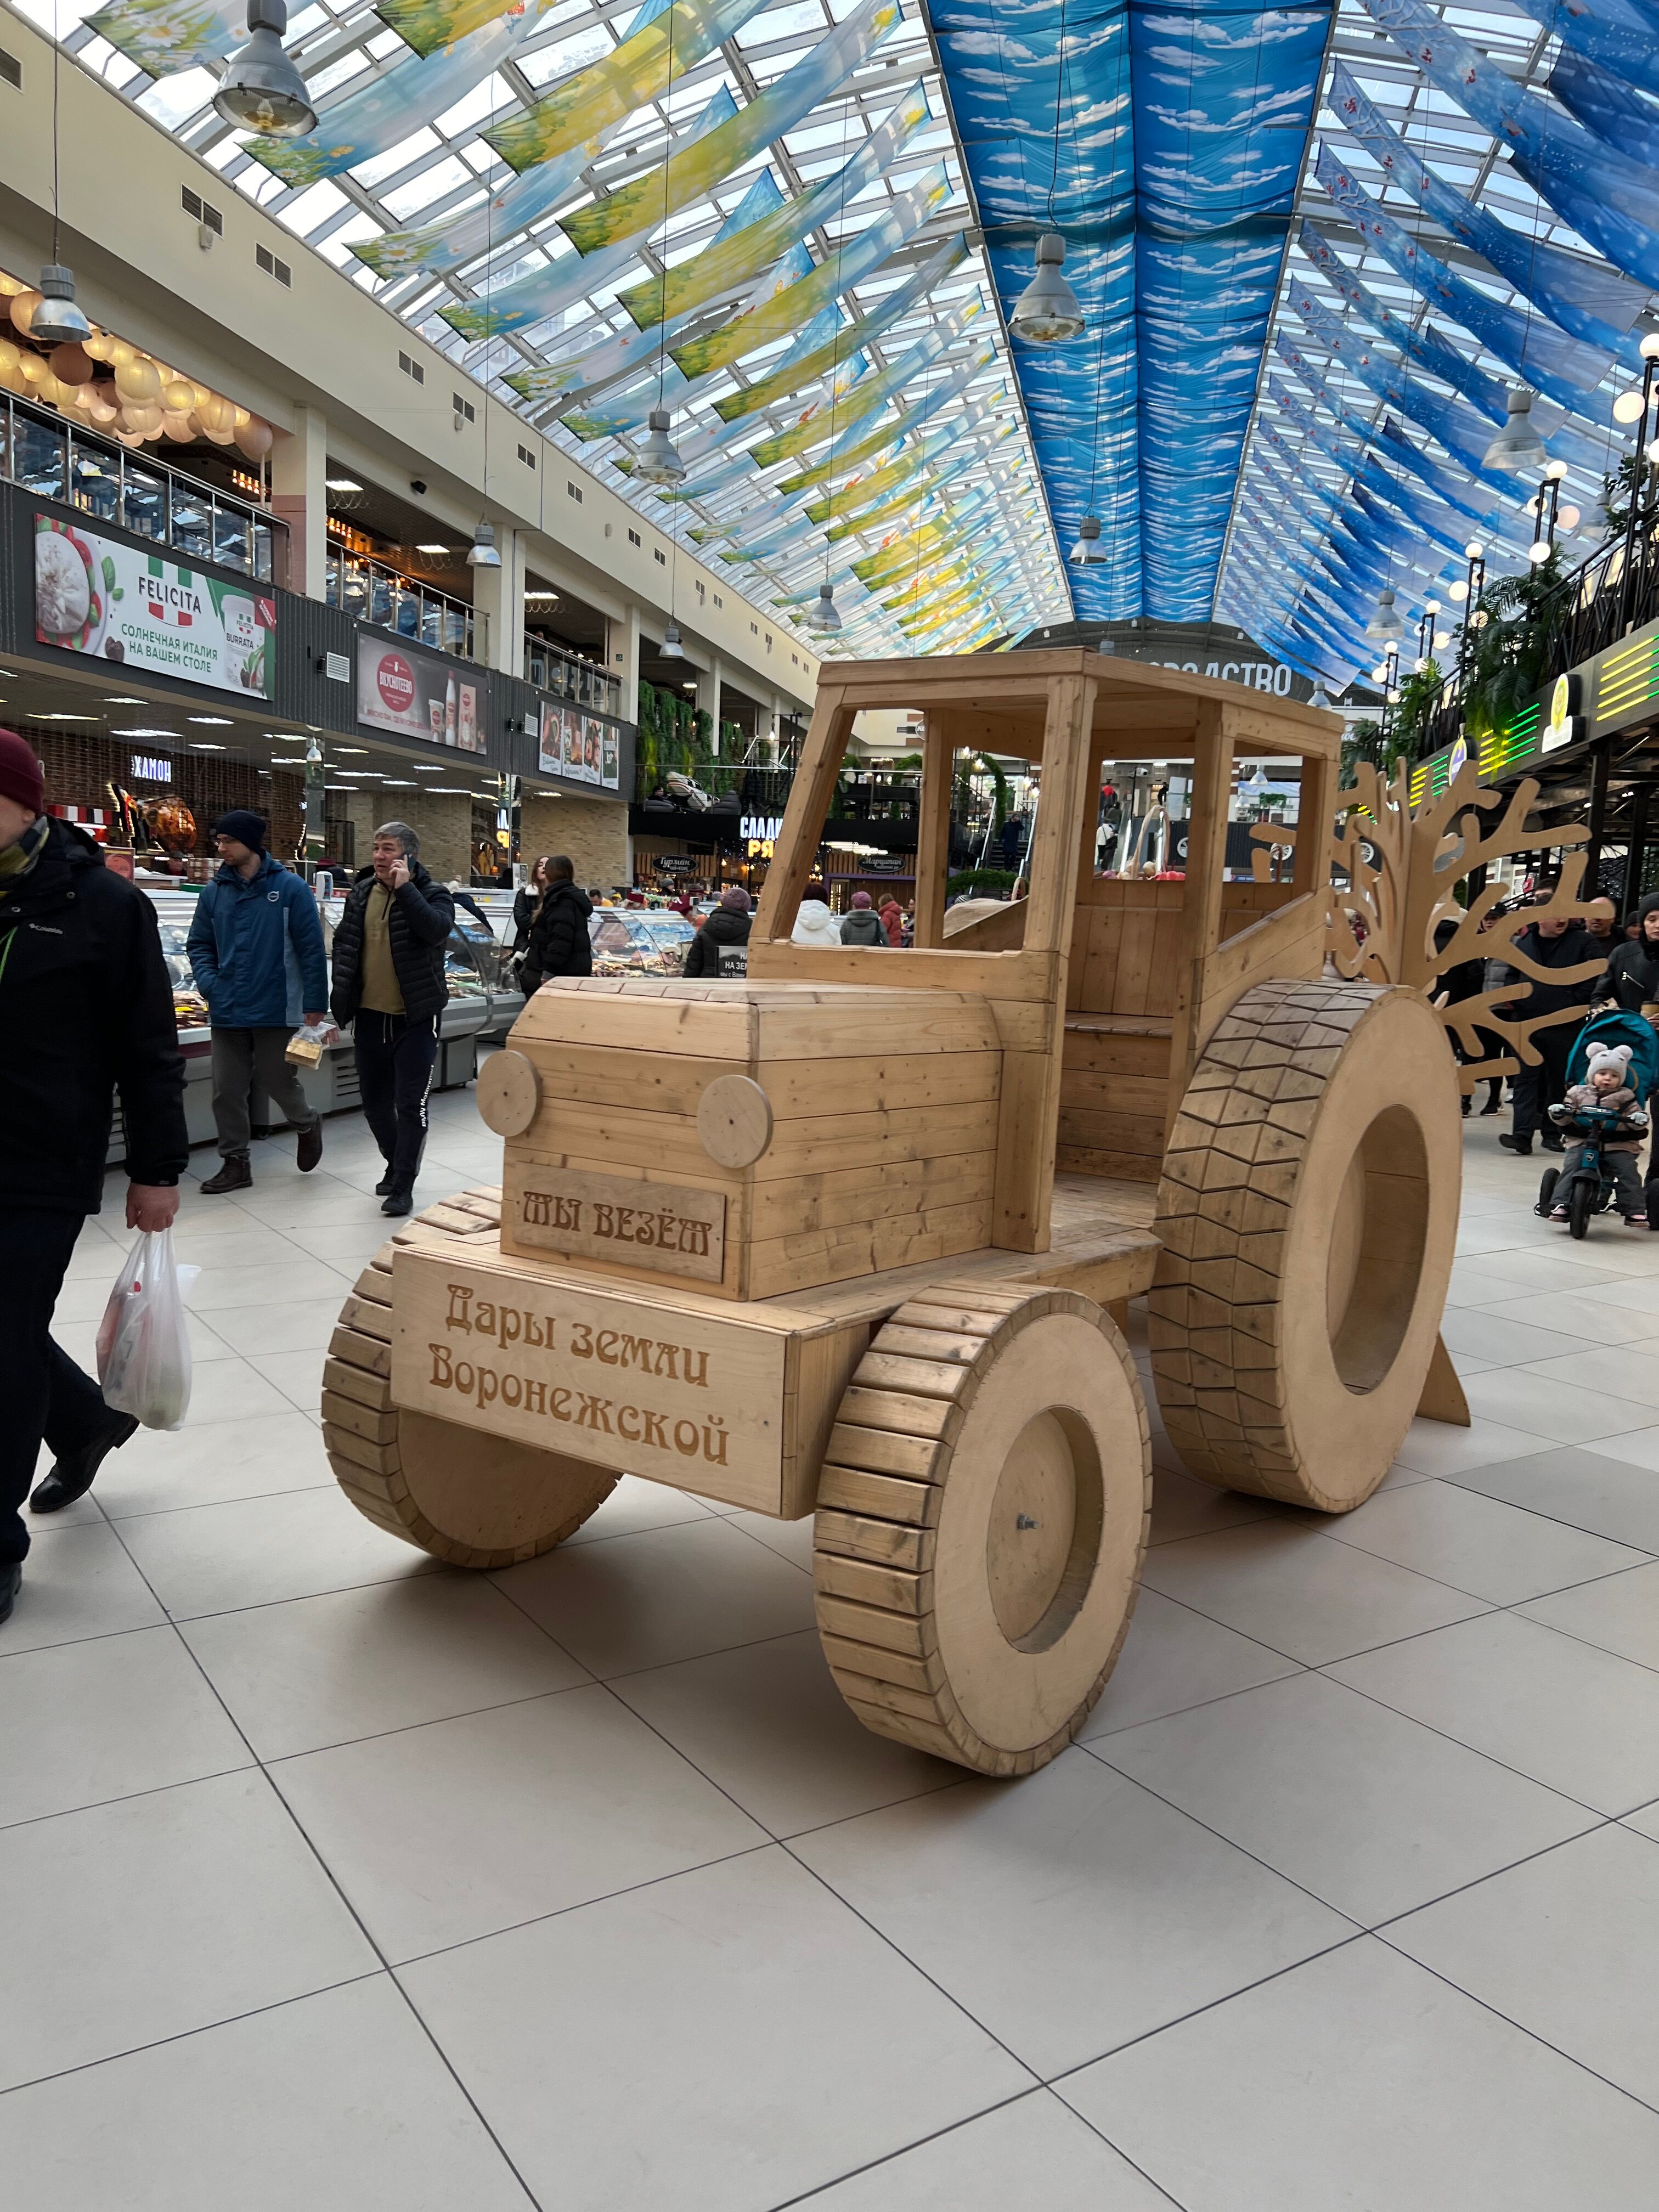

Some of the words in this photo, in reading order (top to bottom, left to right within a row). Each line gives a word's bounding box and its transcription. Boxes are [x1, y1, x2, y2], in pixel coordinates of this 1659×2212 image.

[139, 577, 201, 614] FELICITA
[121, 623, 180, 650] СОЛНЕЧНАЯ
[183, 641, 217, 661] ИТАЛИЯ
[129, 641, 144, 656] НА
[146, 646, 180, 665] ВАШЕМ
[183, 656, 211, 673] СТОЛЕ
[226, 633, 254, 650] BURRATA
[379, 671, 413, 695] ВКУСНОТЕЕВО
[134, 755, 171, 782] ХАМОН
[725, 961, 735, 969] НА
[736, 962, 747, 970] ЗЕ
[523, 1190, 583, 1232] МЫ
[592, 1203, 713, 1256] ВЕЗЁМ
[445, 1283, 556, 1351] Дары
[571, 1323, 710, 1388] земли
[428, 1342, 730, 1466] Воронежской
